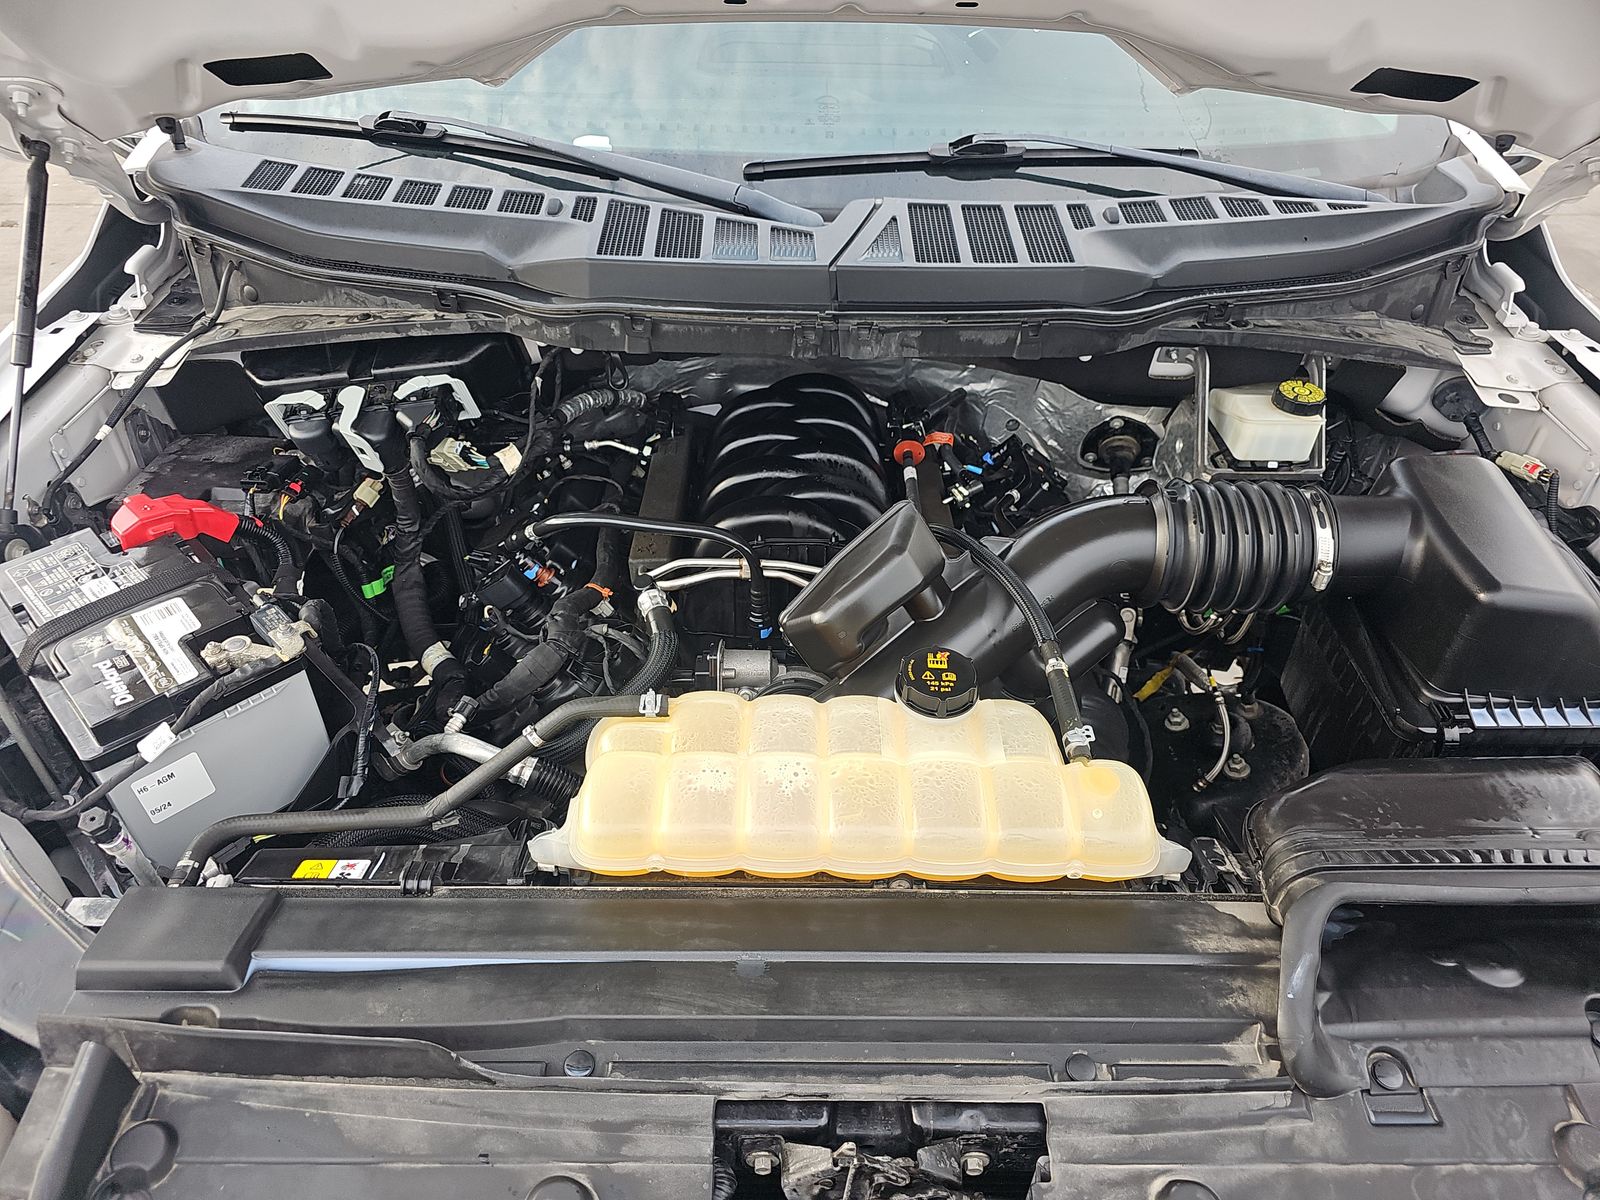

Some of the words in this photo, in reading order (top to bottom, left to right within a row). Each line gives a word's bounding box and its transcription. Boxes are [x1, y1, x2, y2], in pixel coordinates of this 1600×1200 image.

[92, 658, 135, 706] DieHard
[136, 785, 149, 795] H6
[157, 772, 176, 786] AGM
[149, 801, 172, 816] 05/24
